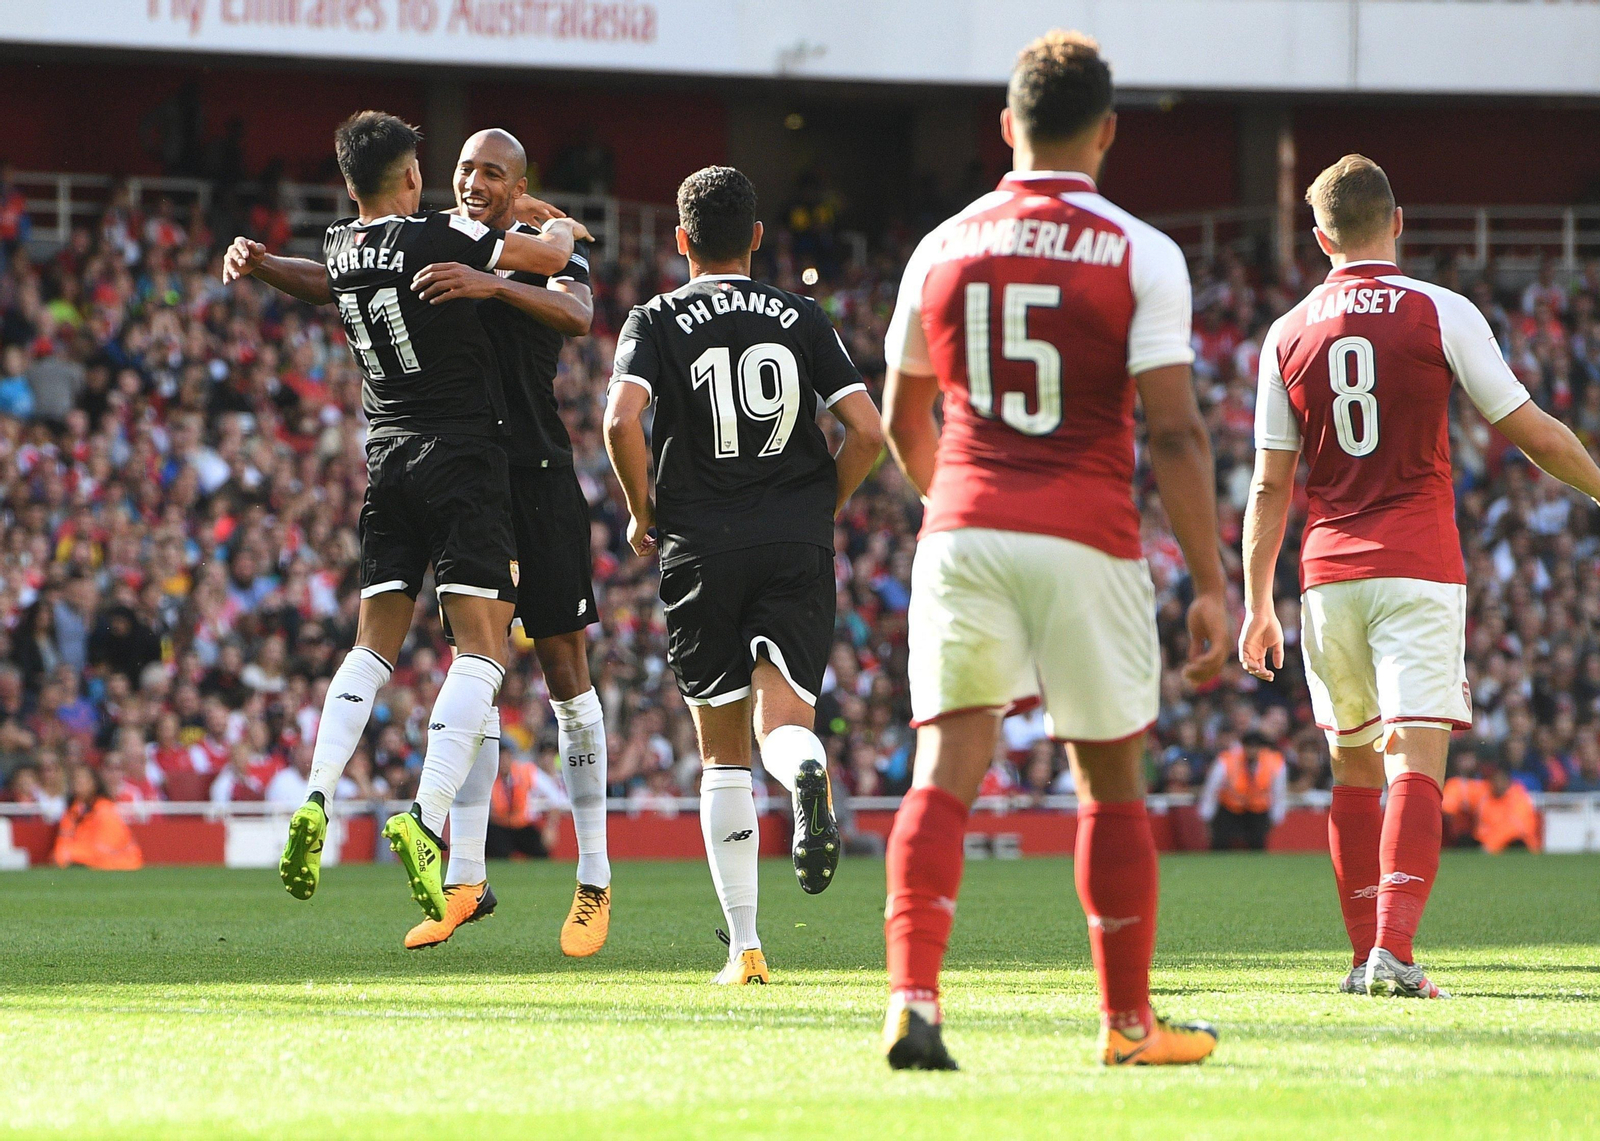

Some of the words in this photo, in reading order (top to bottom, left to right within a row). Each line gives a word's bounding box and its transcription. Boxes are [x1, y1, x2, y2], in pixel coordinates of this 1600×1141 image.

[448, 0, 658, 43] Australasia
[326, 247, 405, 280] CORREA
[675, 300, 713, 335] PH
[711, 290, 799, 329] GANSO
[1306, 288, 1406, 326] RAMSEY
[338, 287, 422, 379] 11
[964, 282, 1062, 436] 15
[690, 342, 800, 459] 19
[1327, 335, 1379, 457] 8
[568, 753, 596, 767] SFC
[415, 838, 427, 873] adidas
